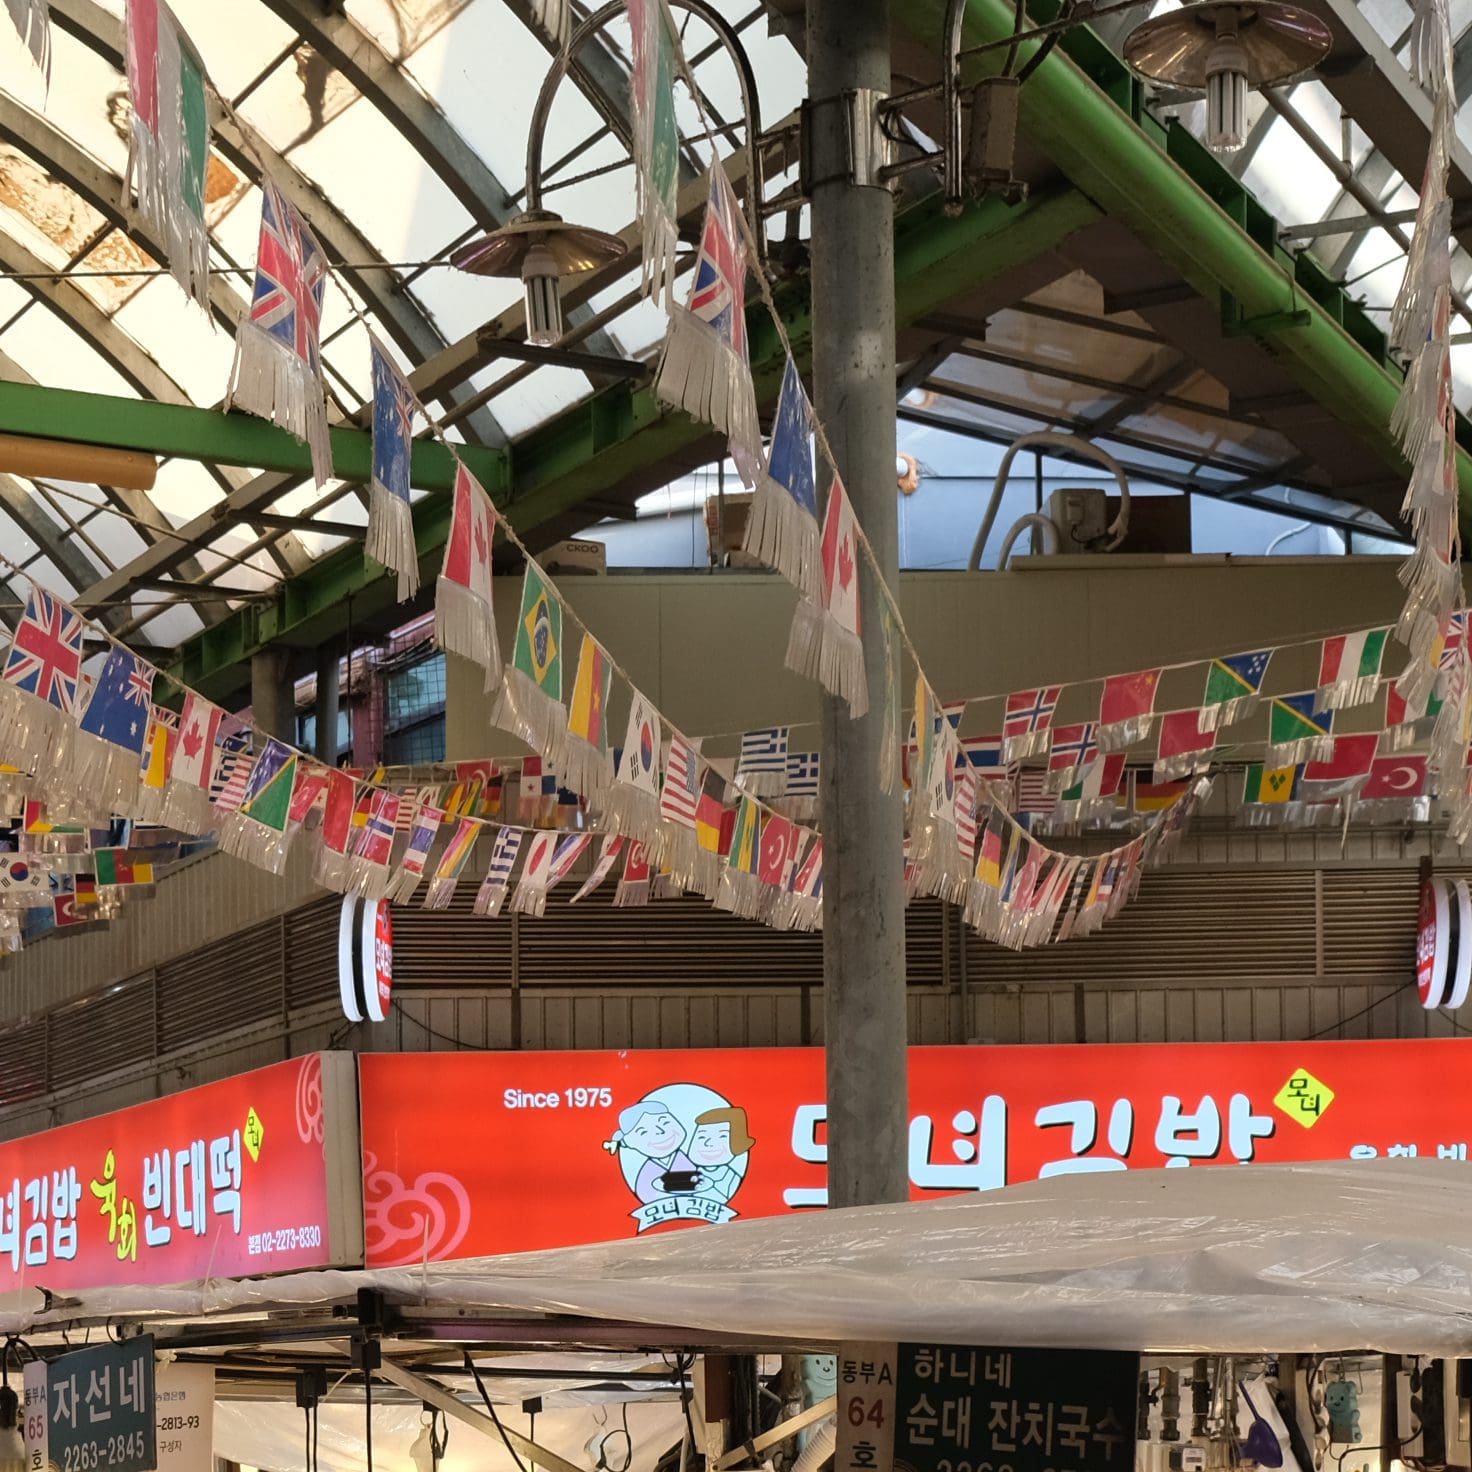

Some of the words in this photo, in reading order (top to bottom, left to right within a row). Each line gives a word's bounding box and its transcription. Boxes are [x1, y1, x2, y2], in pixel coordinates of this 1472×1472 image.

[504, 1088, 560, 1108] Since
[564, 1088, 612, 1107] 1975
[143, 1128, 243, 1247] 빈대떡
[645, 1198, 679, 1224] 모녀
[686, 1198, 726, 1222] 김밥
[262, 1224, 321, 1252] 02-2273-8330
[842, 1361, 893, 1385] 동부A
[915, 1349, 1012, 1388] 하니네
[52, 1356, 145, 1429] 자선네
[848, 1396, 884, 1429] 64
[29, 1415, 44, 1440] 65
[906, 1393, 972, 1448] 순대
[988, 1399, 1128, 1461] 잔치국수
[32, 1449, 43, 1471] 호
[160, 1440, 182, 1453] 구성자
[850, 1441, 877, 1469] 호
